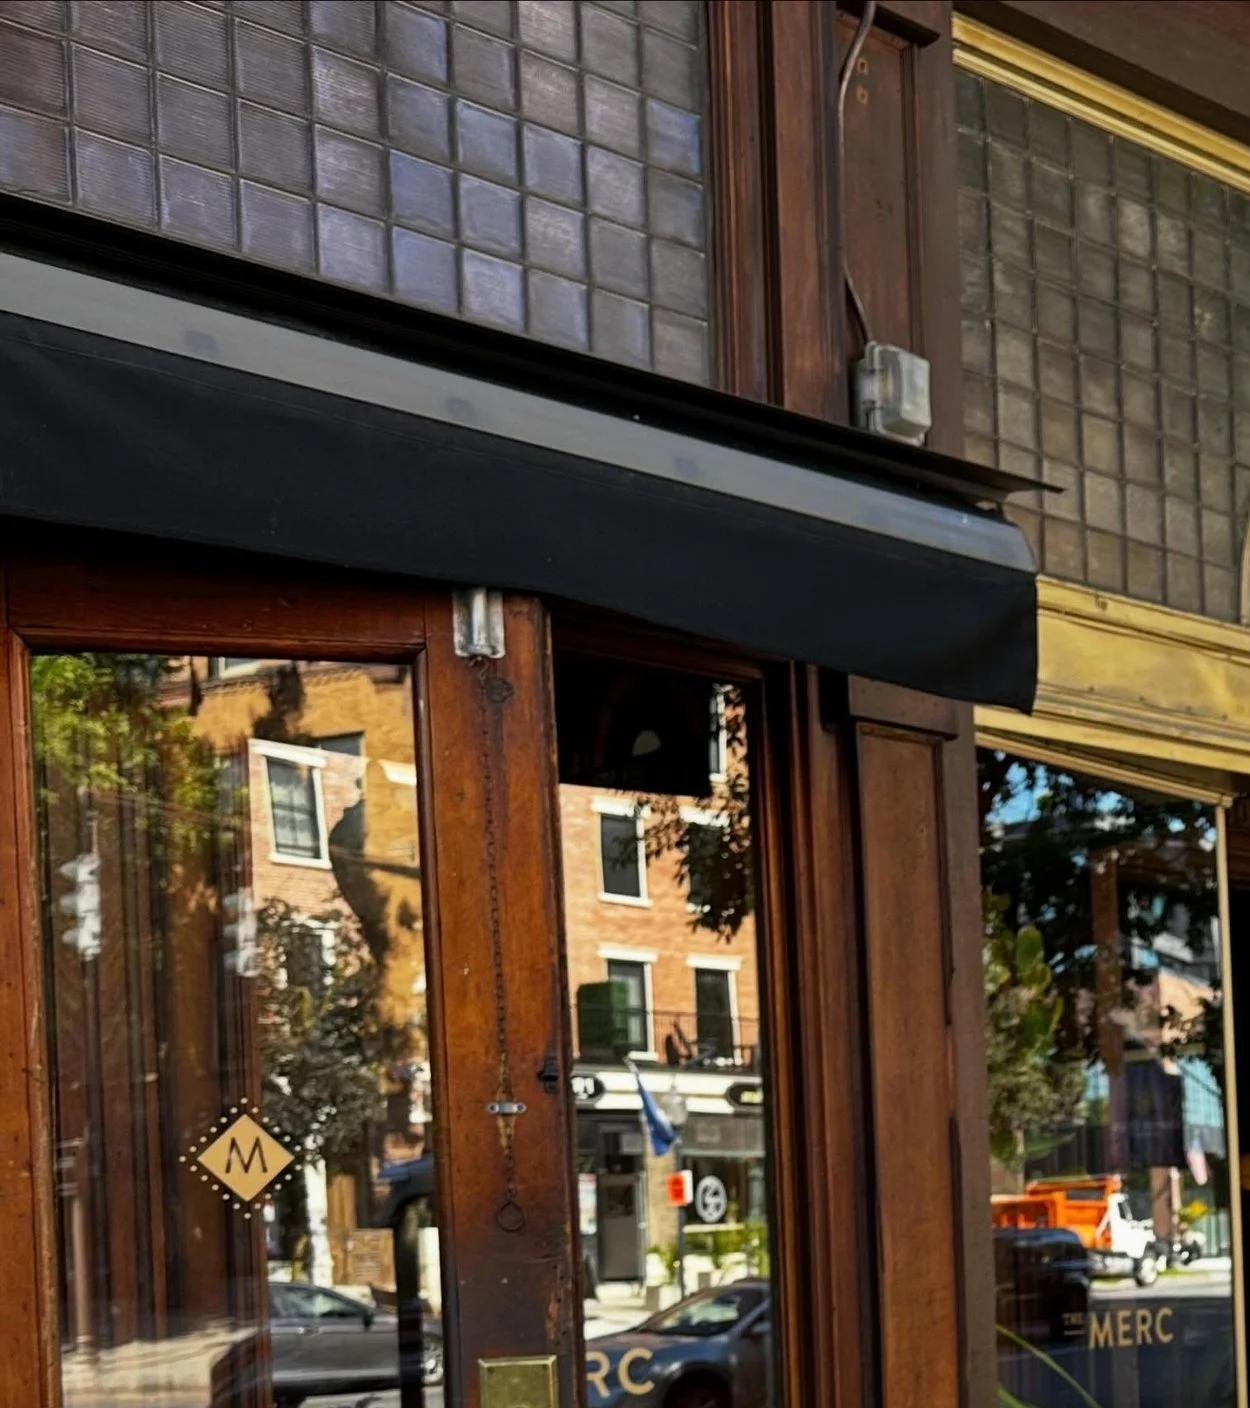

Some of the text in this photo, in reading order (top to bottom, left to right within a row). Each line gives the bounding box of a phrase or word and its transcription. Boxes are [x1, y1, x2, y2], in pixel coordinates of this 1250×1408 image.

[225, 1136, 268, 1174] M
[1089, 1306, 1174, 1349] MERC
[585, 1348, 655, 1398] RC
